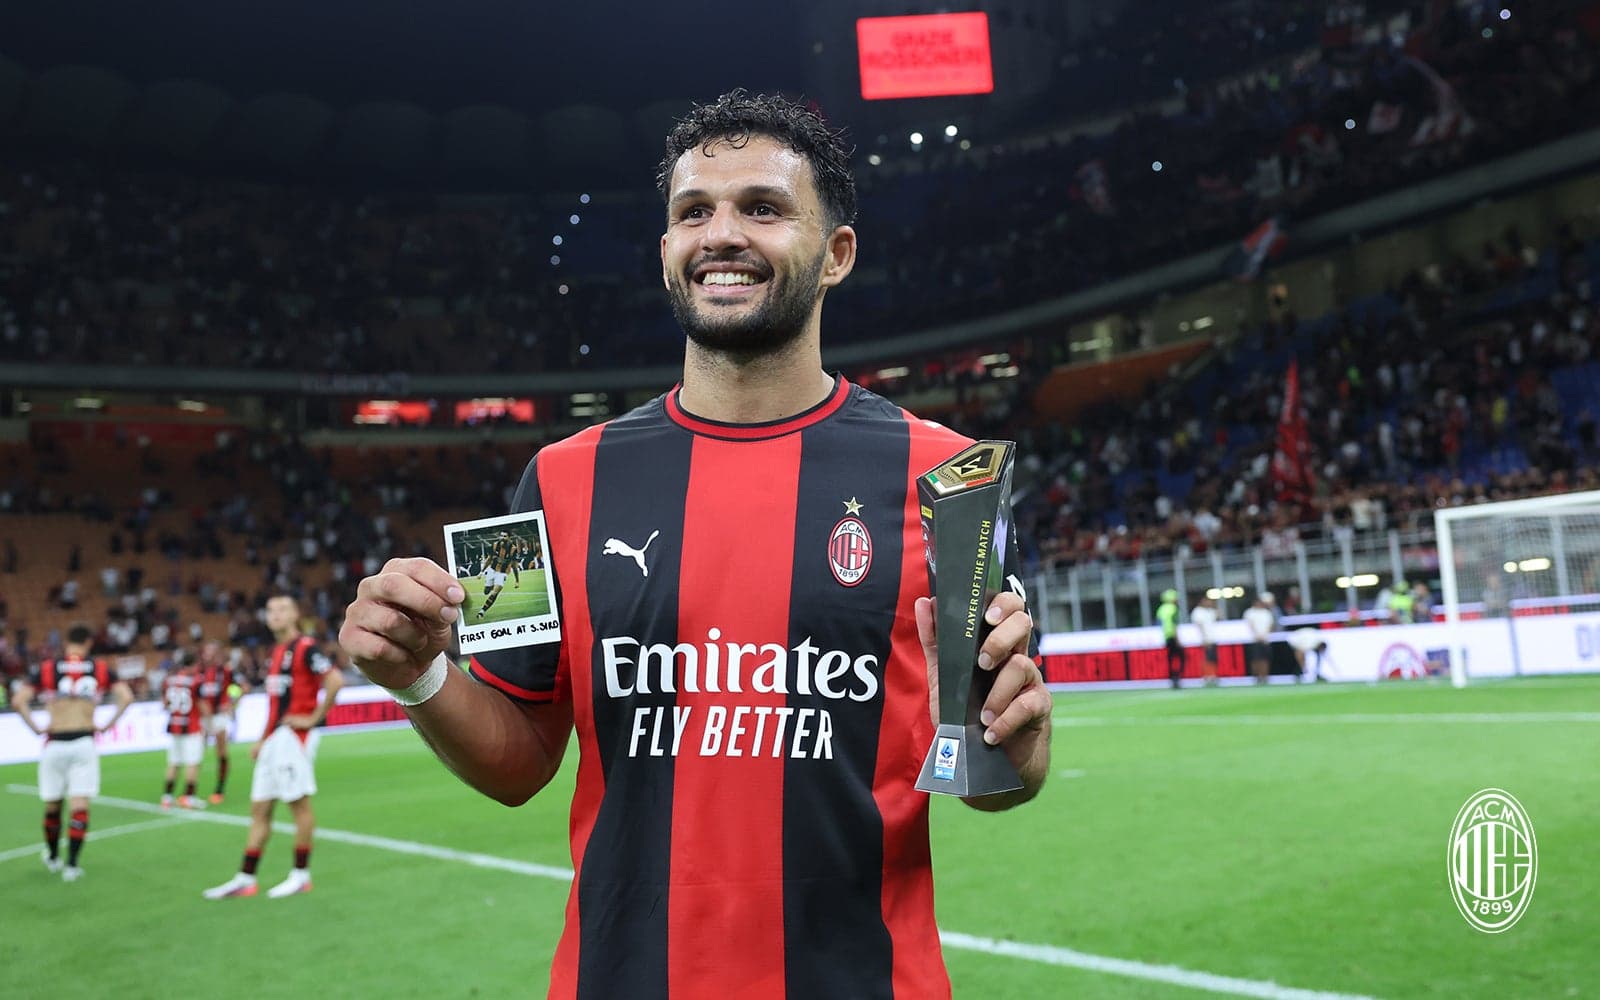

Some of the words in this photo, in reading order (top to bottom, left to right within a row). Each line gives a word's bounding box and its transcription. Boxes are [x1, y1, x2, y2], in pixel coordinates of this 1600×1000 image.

[840, 523, 863, 536] ACM
[976, 520, 991, 559] MATCH
[839, 569, 860, 577] 1899
[973, 559, 985, 581] THE
[971, 581, 981, 597] OF
[965, 598, 978, 638] PLAYER
[460, 631, 485, 644] FIRST
[490, 627, 512, 639] GOAL
[516, 625, 526, 634] AT
[601, 627, 878, 701] Emirates
[628, 706, 691, 758] FLY
[699, 705, 834, 760] BETTER
